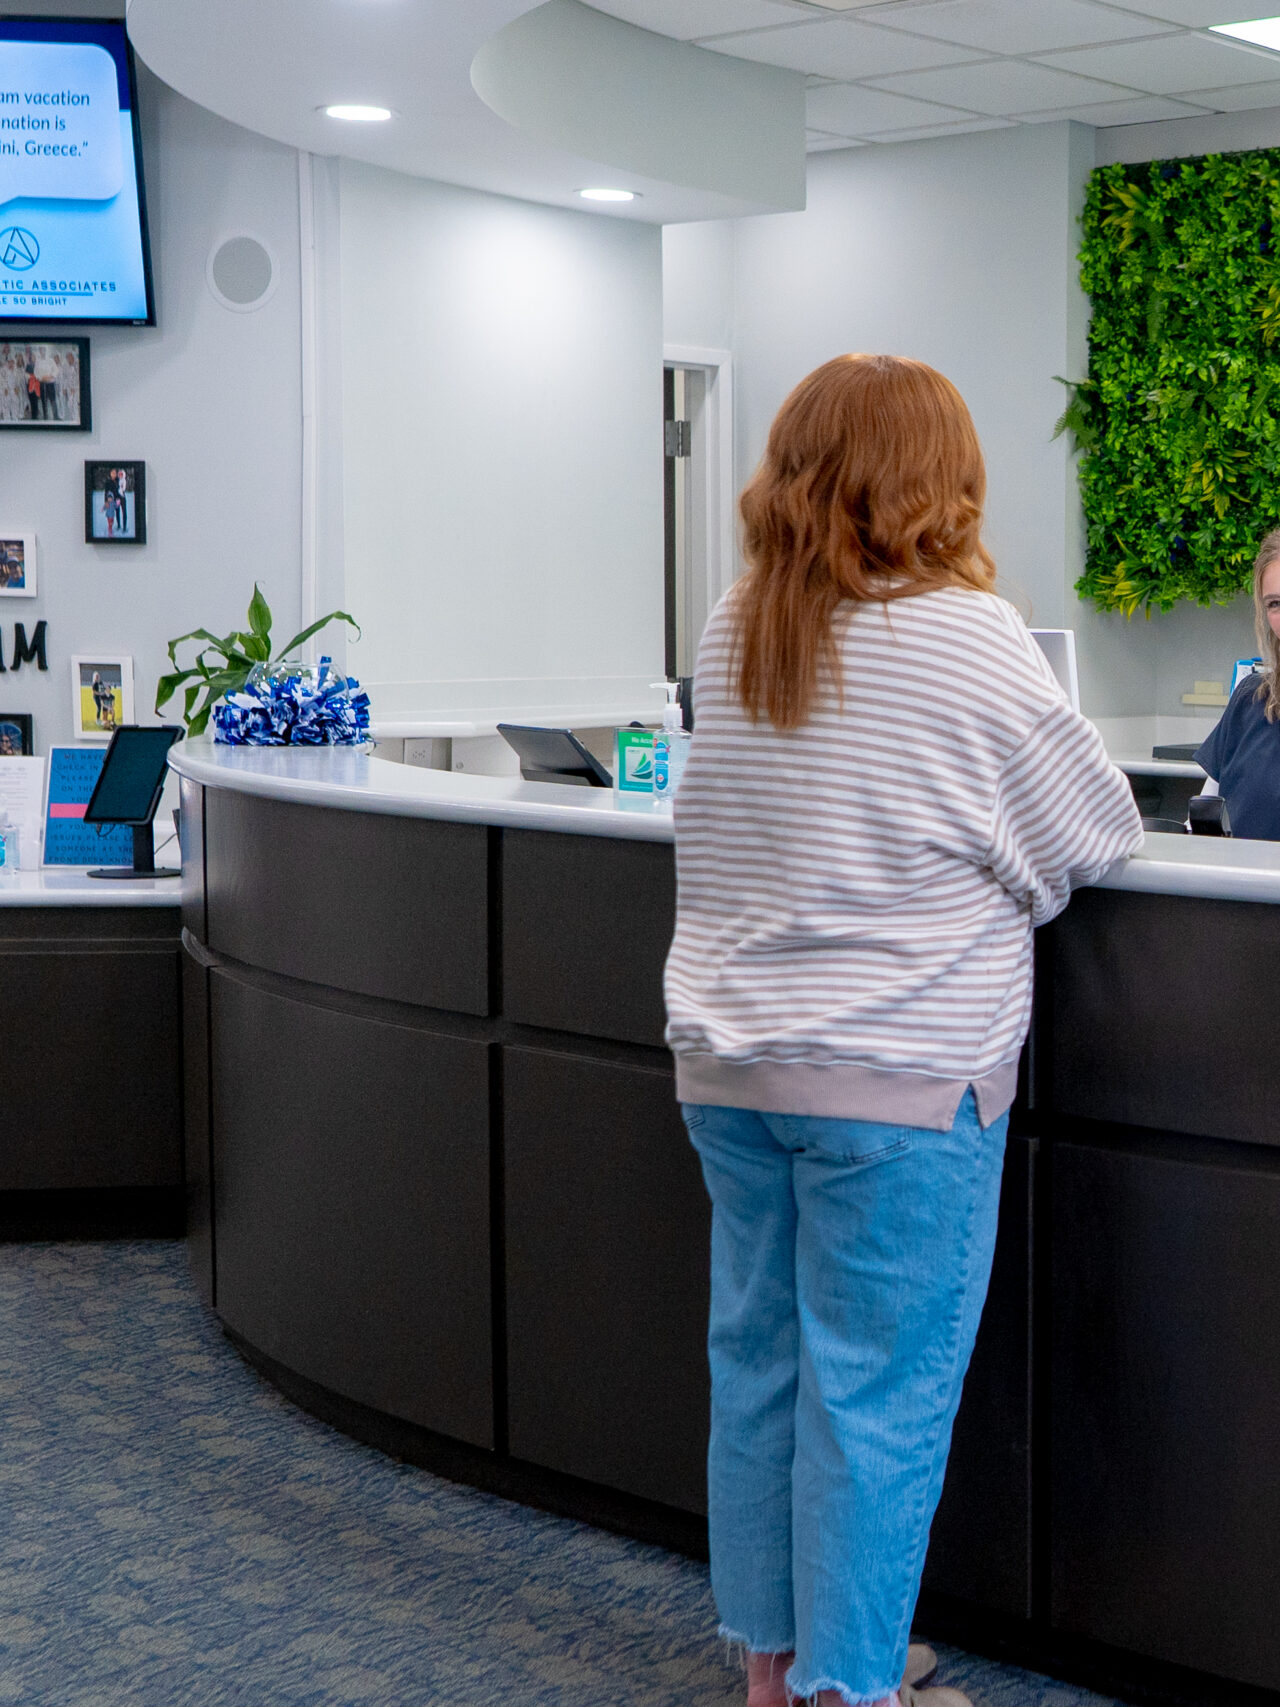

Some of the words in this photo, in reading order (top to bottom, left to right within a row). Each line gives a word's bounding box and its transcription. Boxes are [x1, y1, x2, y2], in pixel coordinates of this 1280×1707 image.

[24, 89, 90, 106] vacation
[55, 115, 66, 131] is
[25, 140, 88, 157] Greece."
[32, 281, 117, 292] ASSOCIATES
[13, 297, 27, 305] SO
[31, 297, 67, 306] BRIGHT
[0, 620, 48, 672] M
